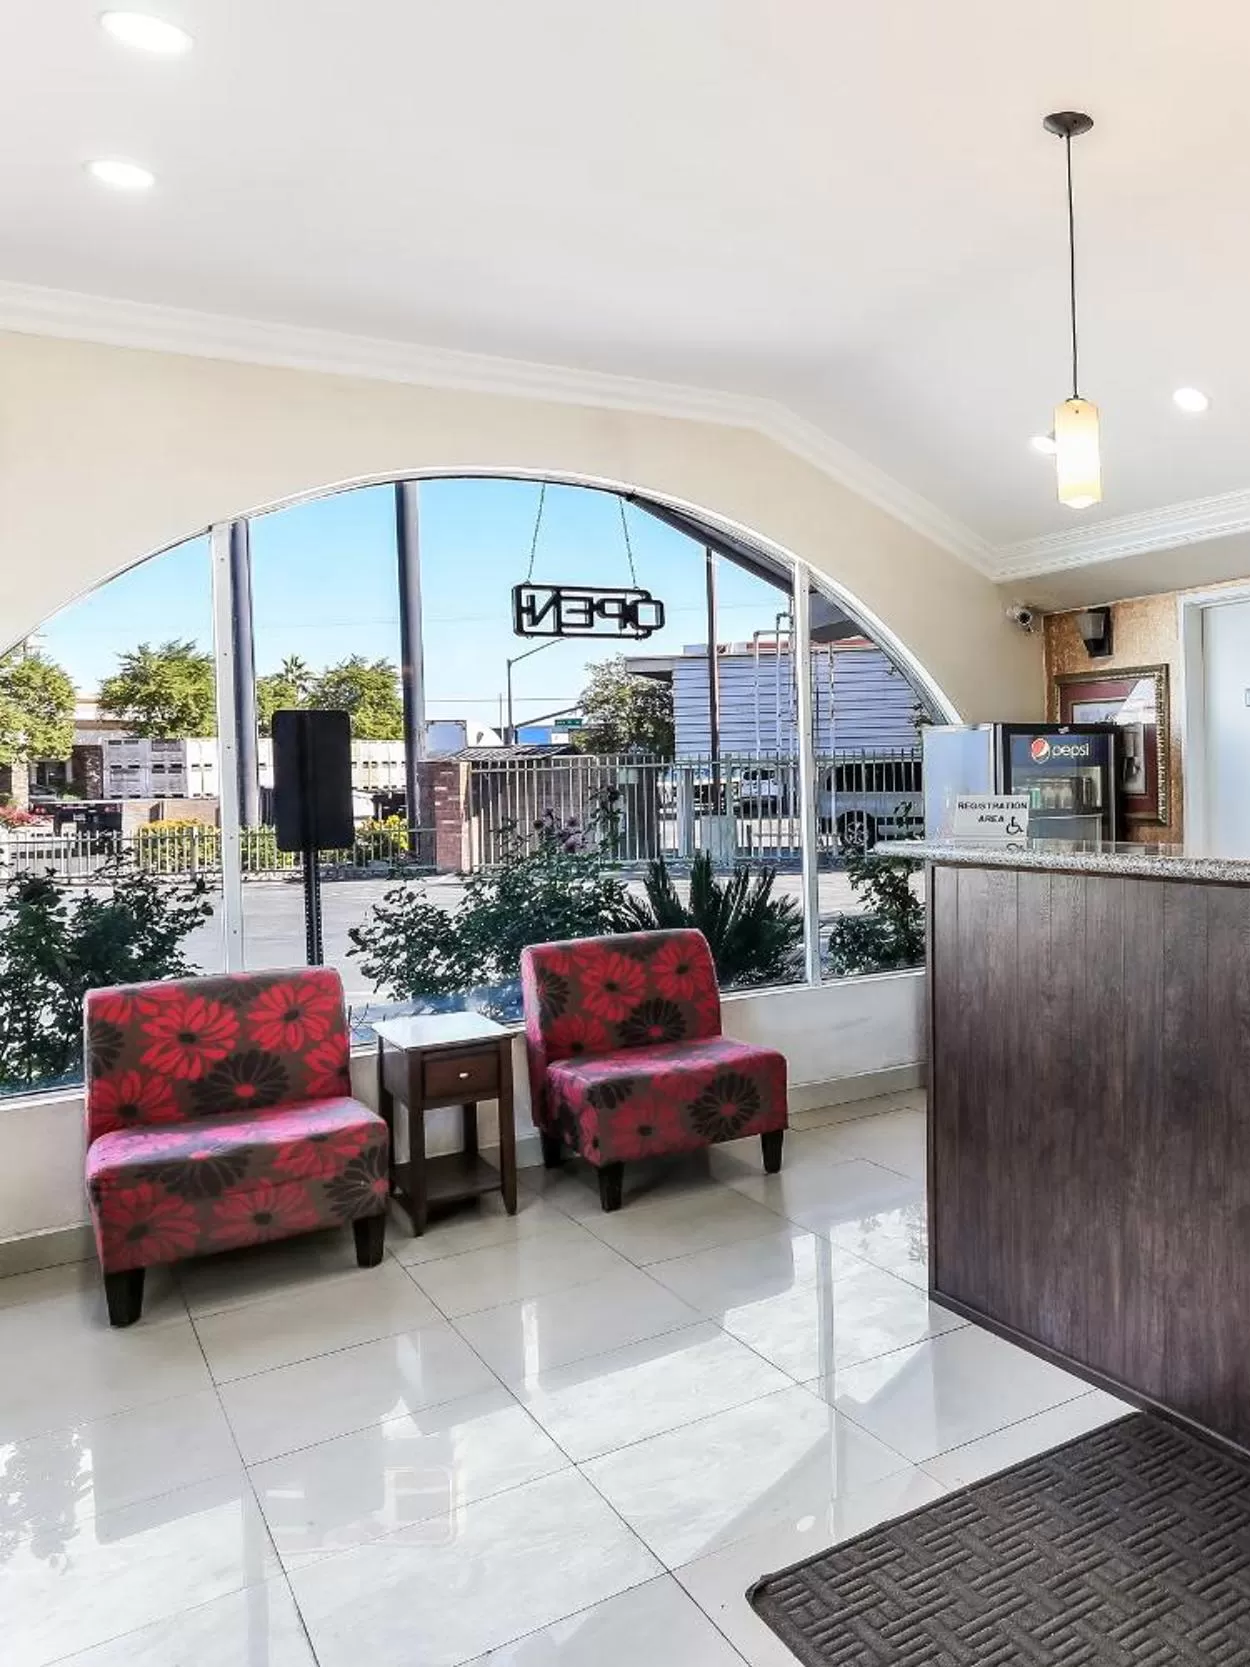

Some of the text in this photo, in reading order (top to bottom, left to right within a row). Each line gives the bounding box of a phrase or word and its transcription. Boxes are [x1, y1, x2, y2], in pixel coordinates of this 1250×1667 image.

[1051, 743, 1090, 758] pepsi
[957, 801, 1028, 810] REGISTRATION
[978, 815, 1004, 823] AREA
